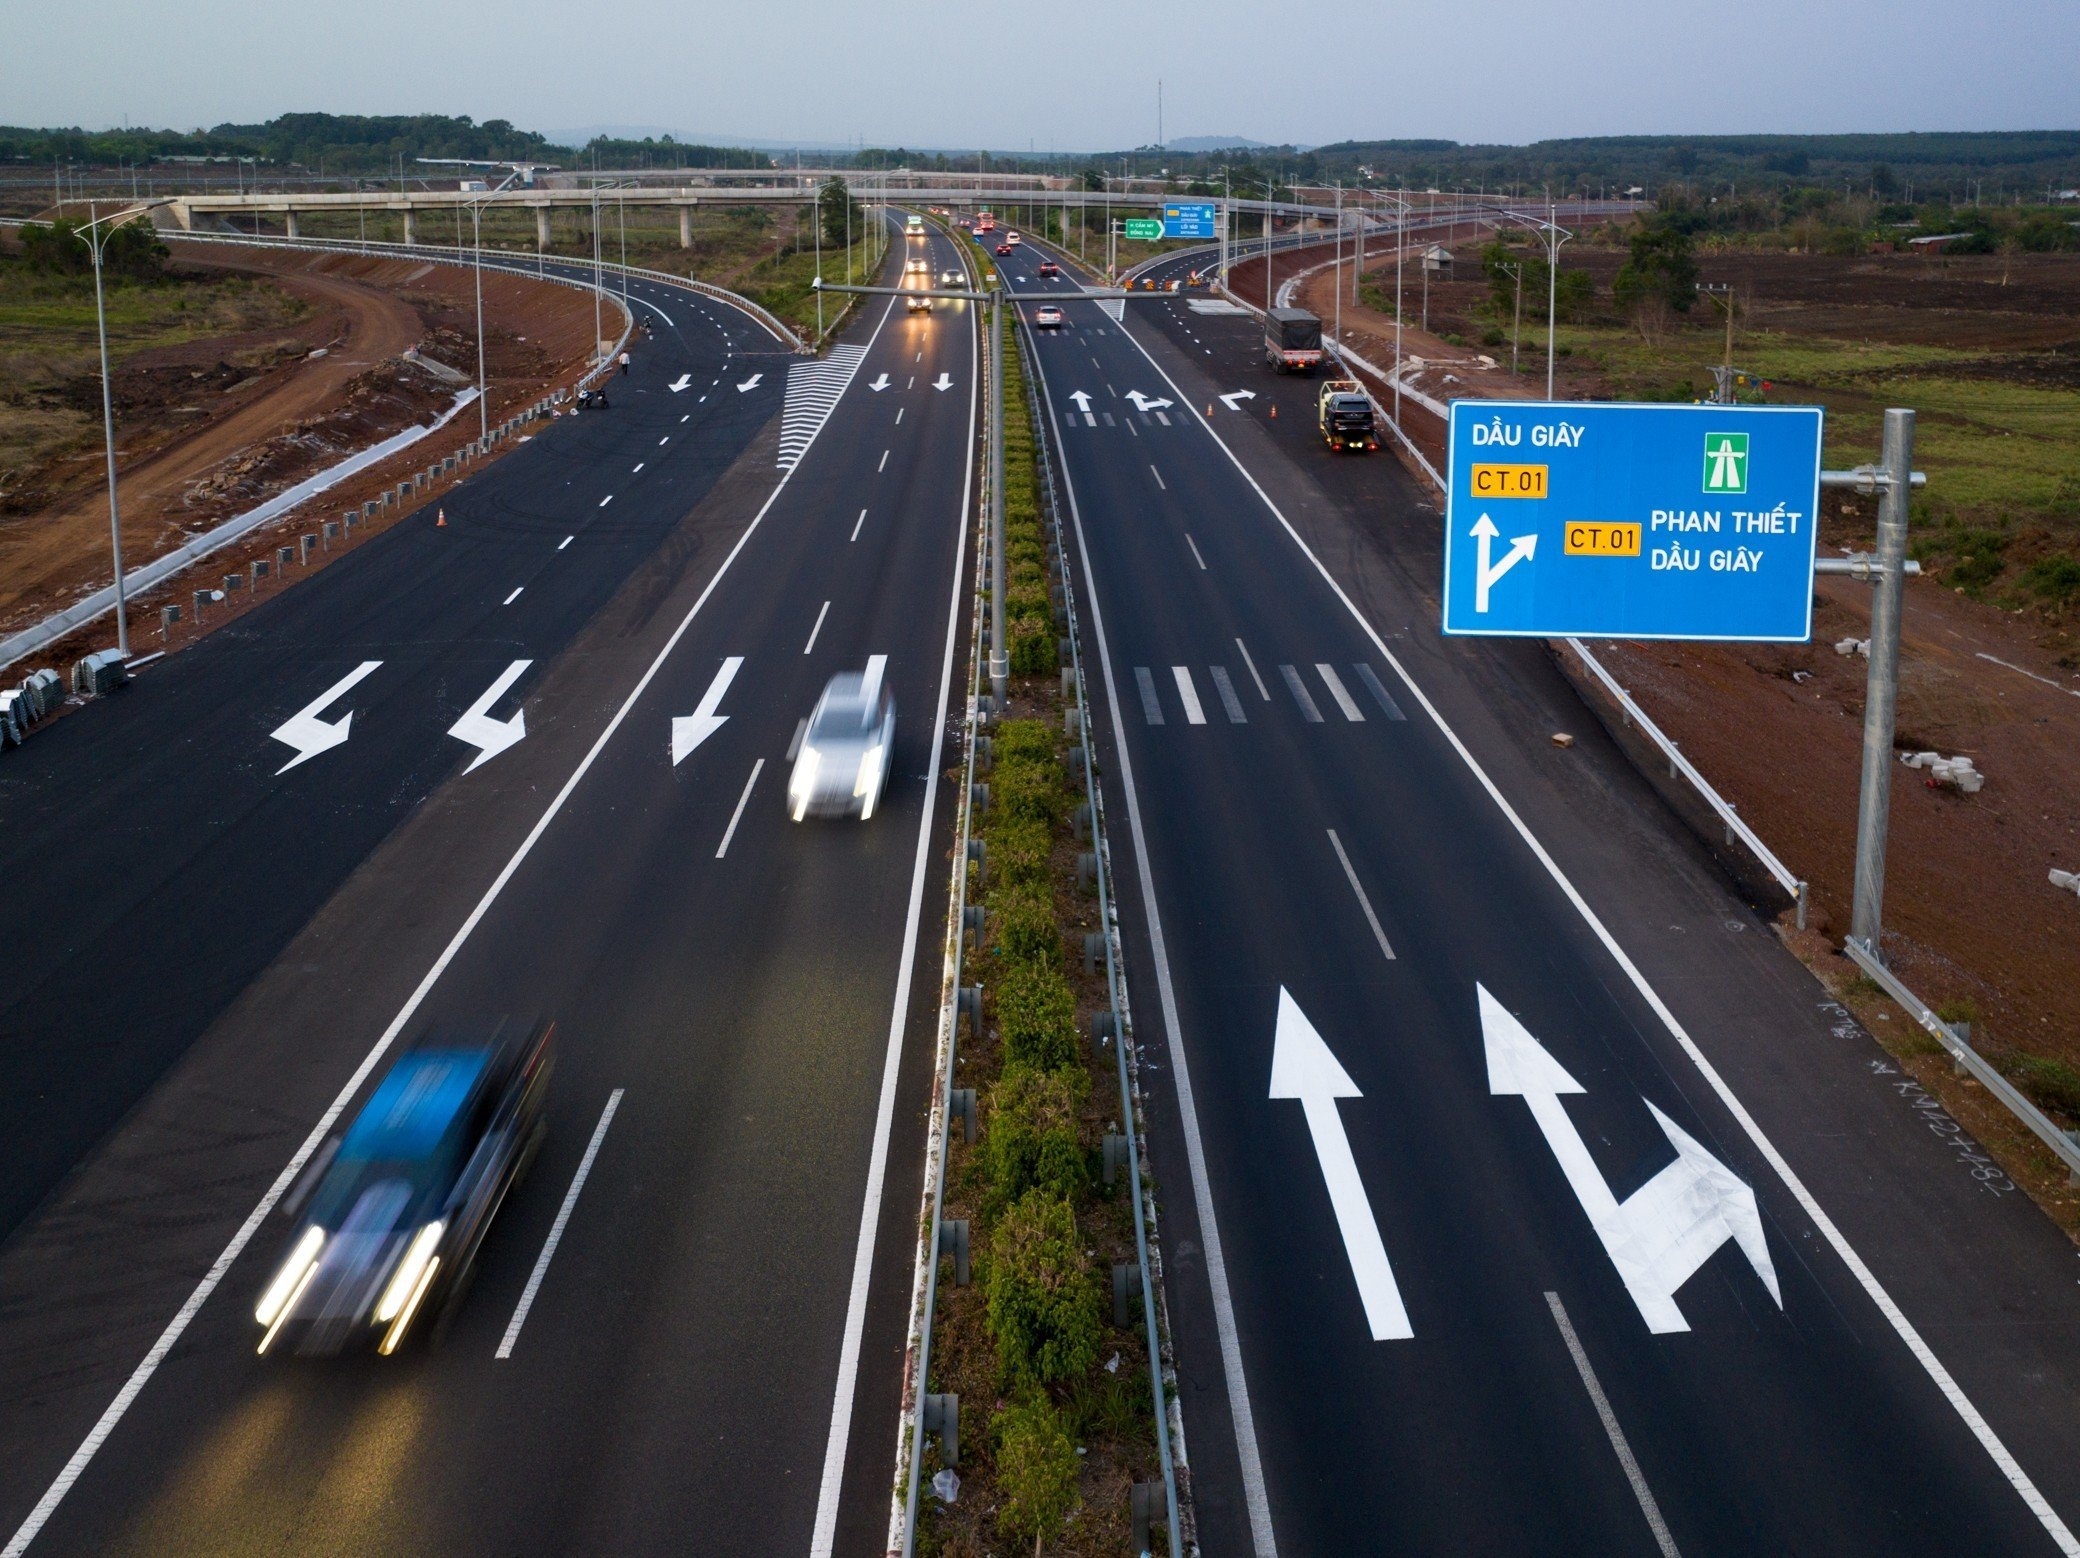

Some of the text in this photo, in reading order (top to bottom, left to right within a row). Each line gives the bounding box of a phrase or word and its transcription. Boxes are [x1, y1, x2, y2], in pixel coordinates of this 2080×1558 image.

[1472, 416, 1586, 448] DẦU GIÂY
[1476, 471, 1542, 492] CT.01
[1651, 502, 1802, 534] PHAN THIẾT
[1570, 528, 1634, 550] CT.01
[1651, 541, 1764, 573] DẦU GIÂY
